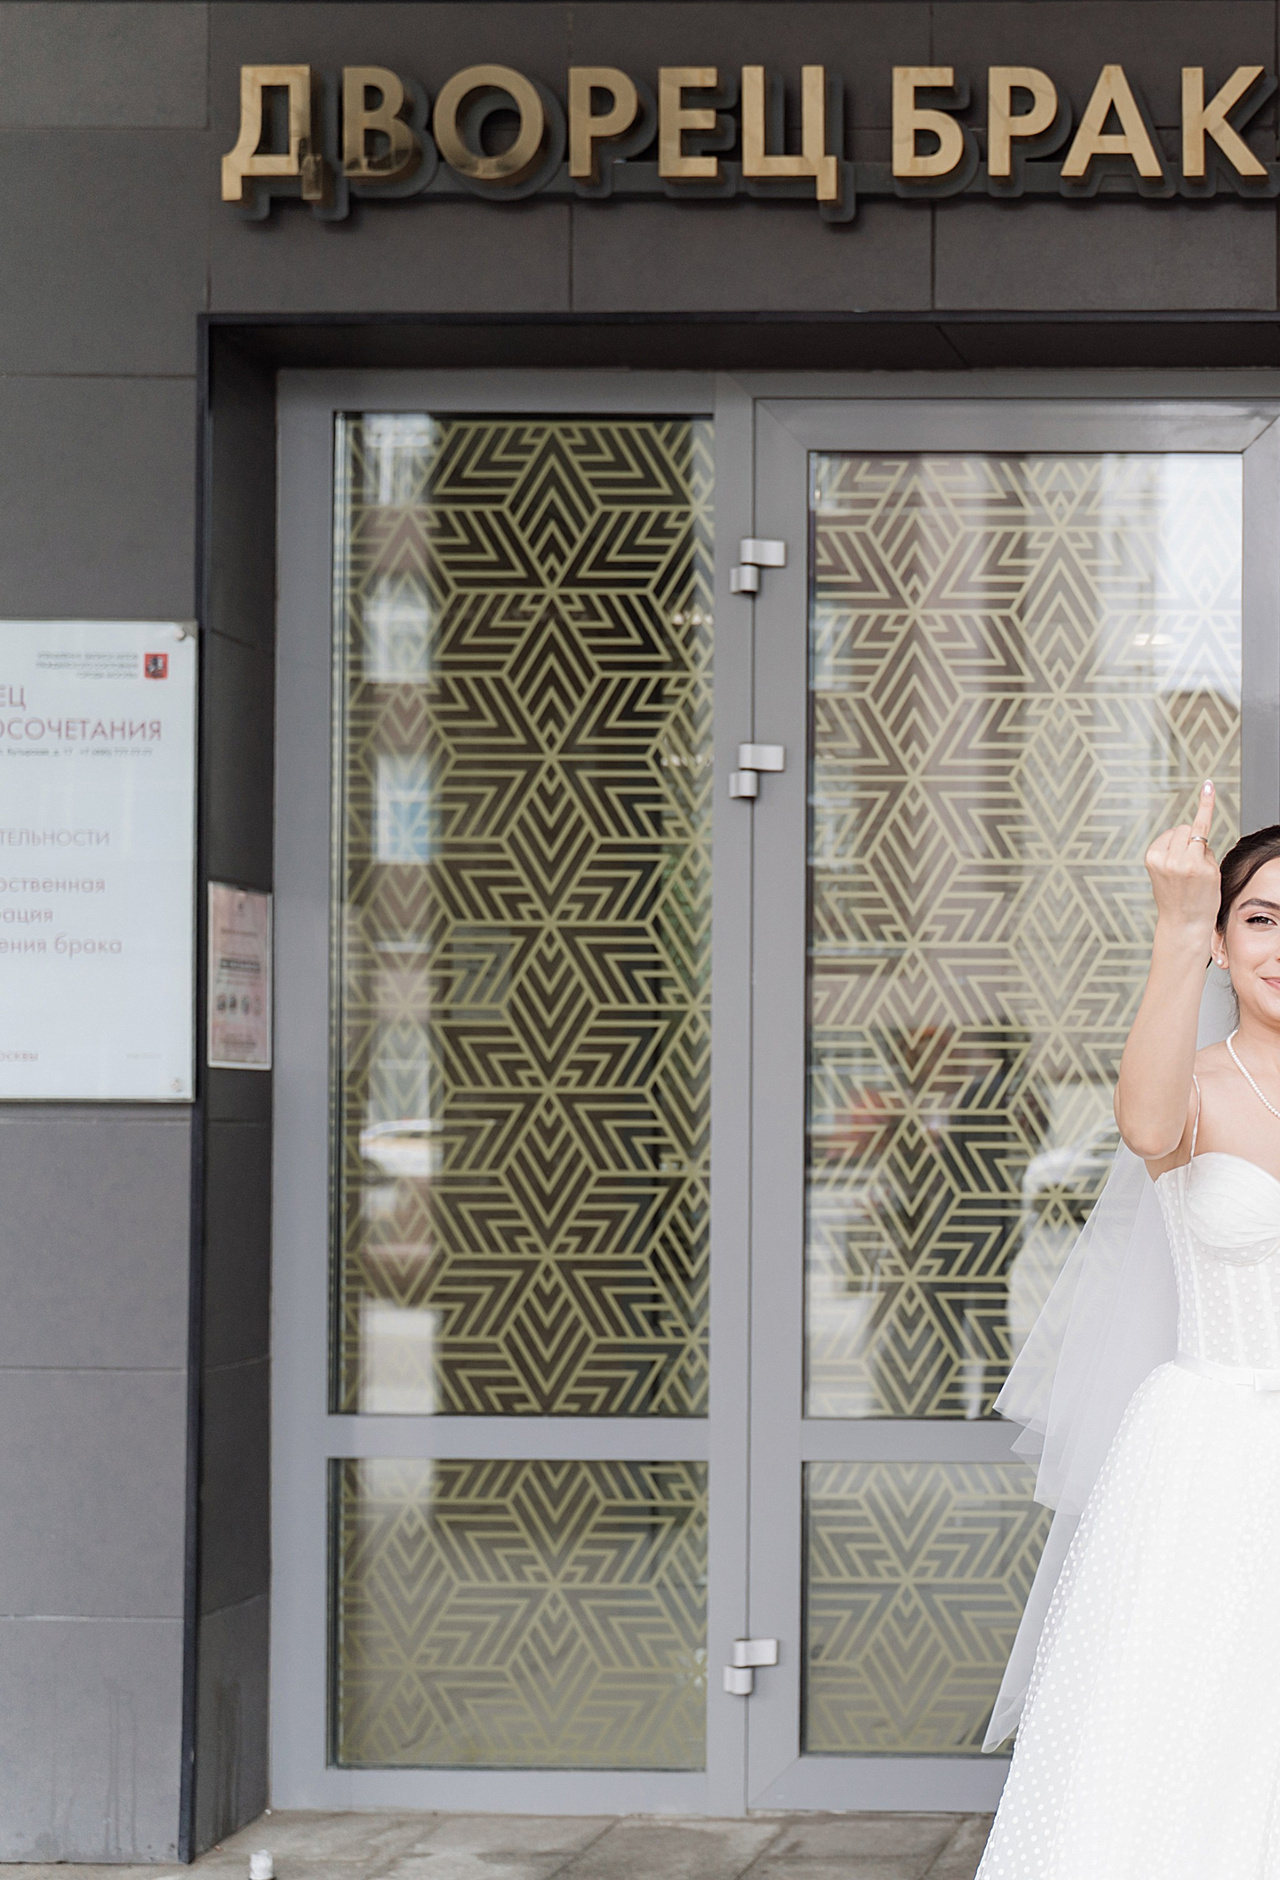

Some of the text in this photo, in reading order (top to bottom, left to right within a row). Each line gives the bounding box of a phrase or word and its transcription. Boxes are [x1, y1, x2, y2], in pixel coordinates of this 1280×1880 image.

[221, 63, 837, 200] ДВОРЕЦ
[0, 718, 161, 740] СОЧЕТАНИЯ
[0, 907, 53, 924] ация
[54, 931, 122, 959] брака
